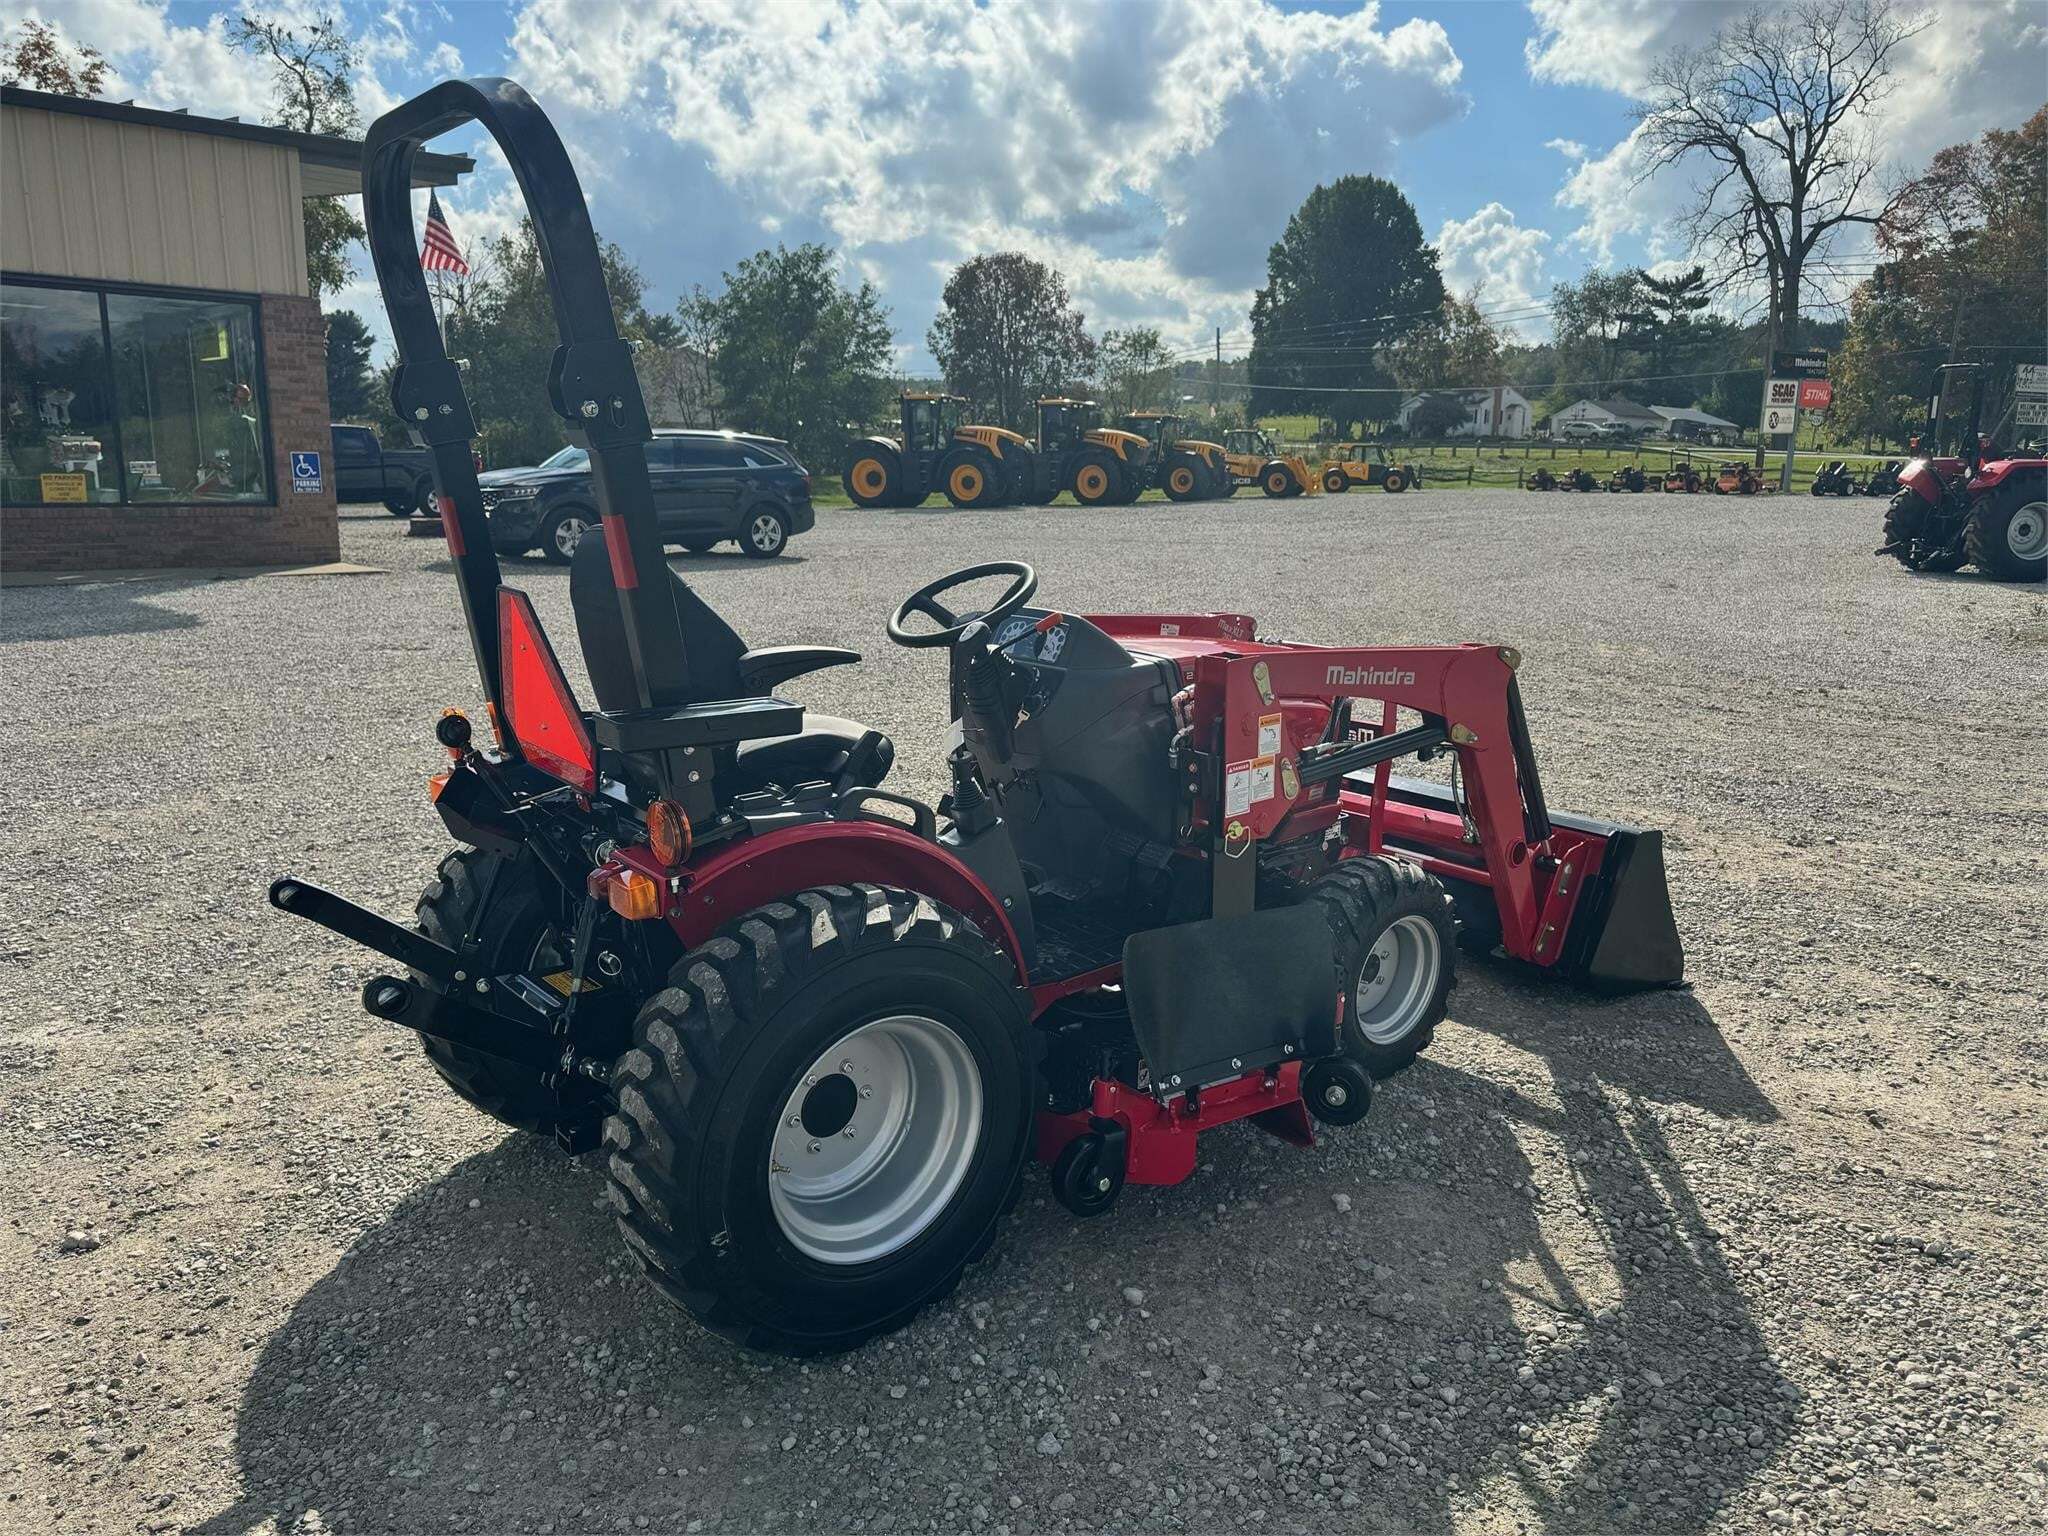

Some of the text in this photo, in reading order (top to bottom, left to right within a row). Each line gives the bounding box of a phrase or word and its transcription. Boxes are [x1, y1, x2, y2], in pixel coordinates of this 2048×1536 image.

[1795, 358, 1826, 367] Mahindra
[1772, 383, 1796, 398] SCAG
[1804, 389, 1828, 401] STIHL
[1232, 477, 1251, 485] JCB
[1325, 665, 1416, 685] Mahindra
